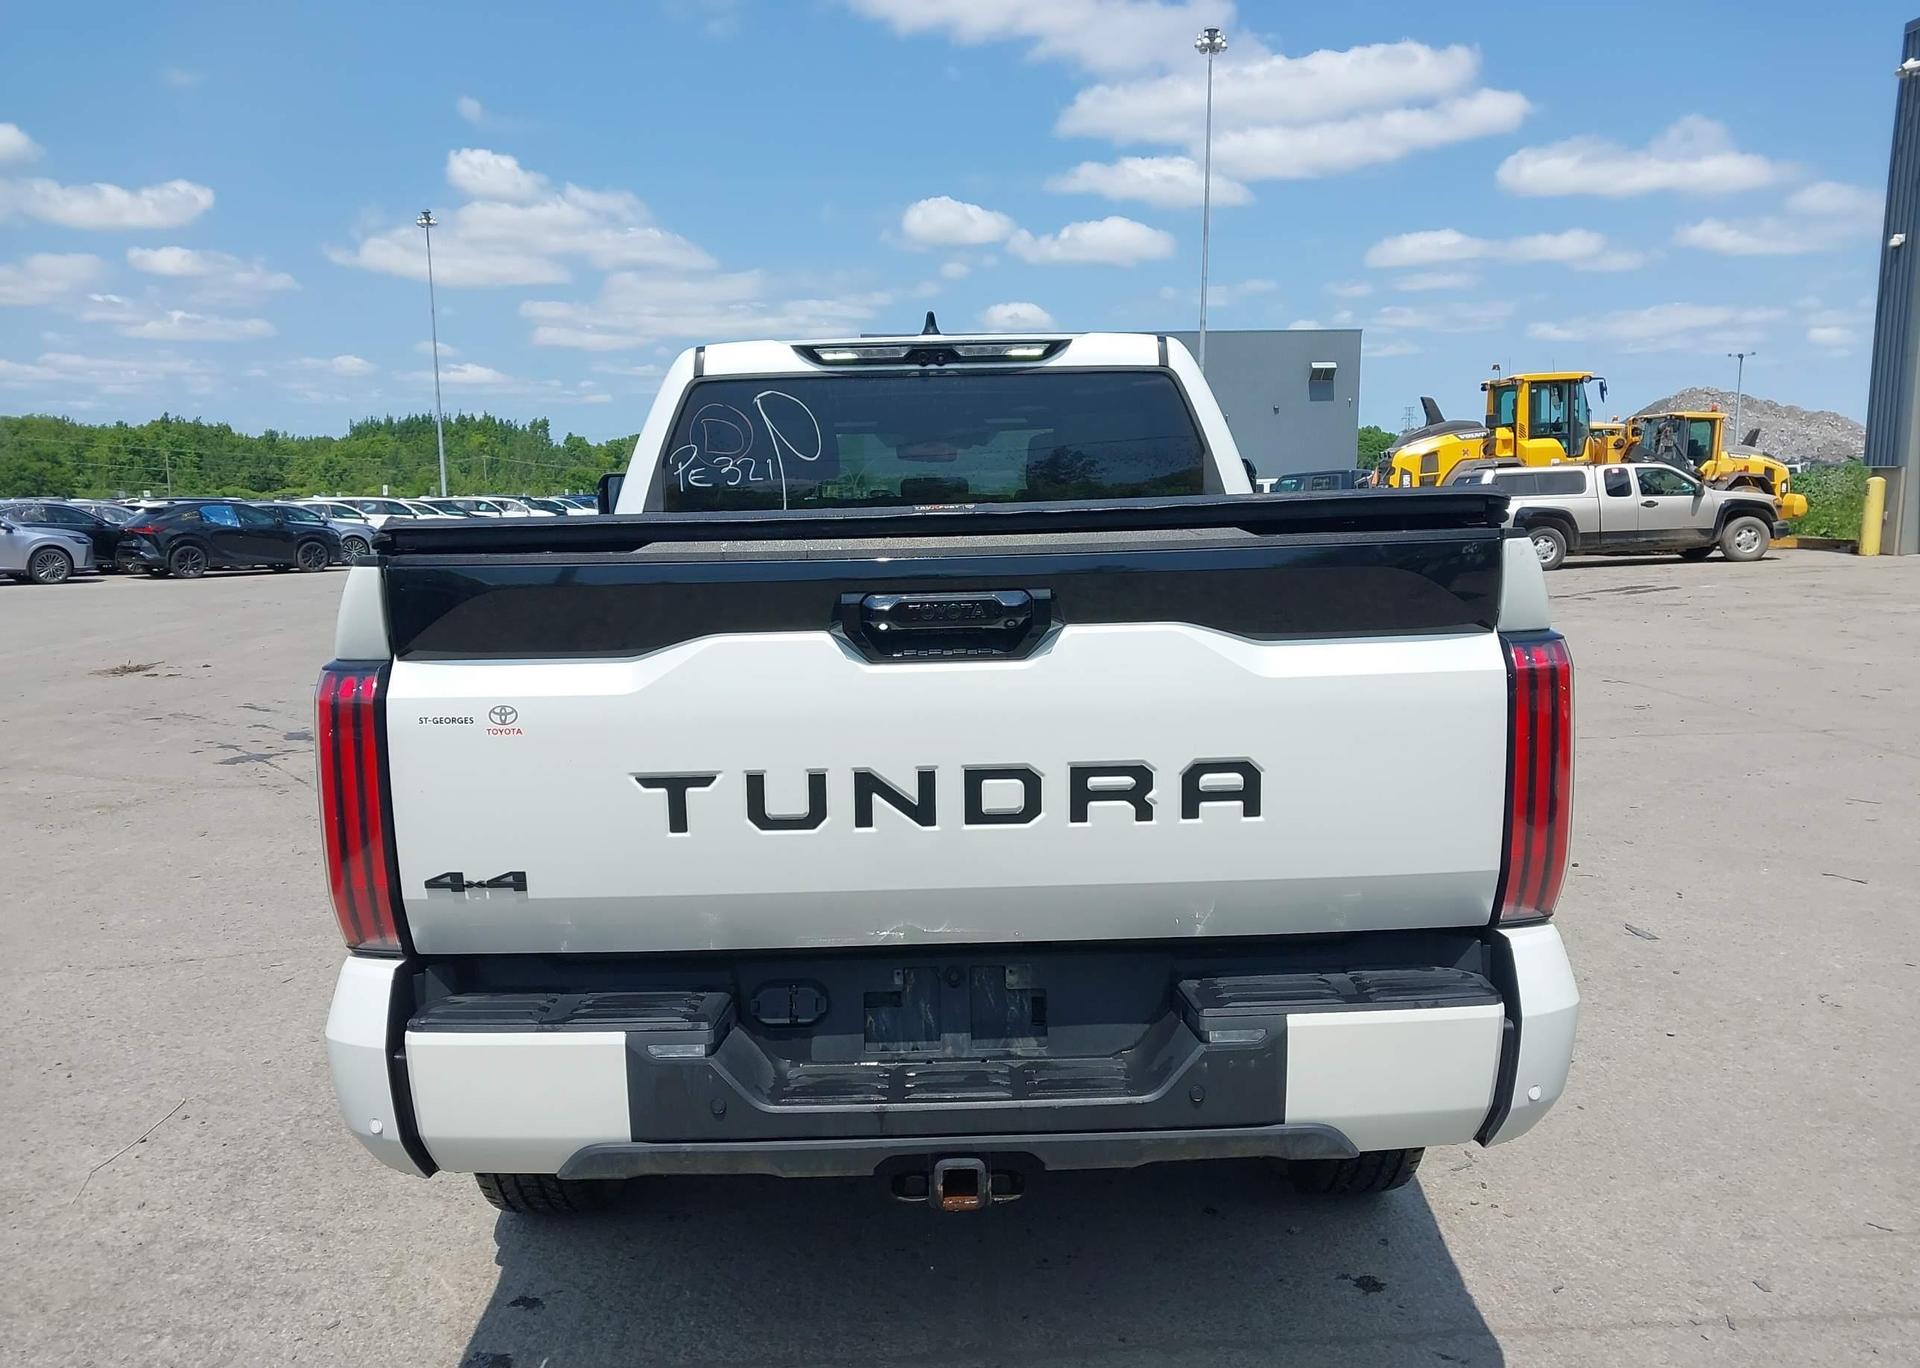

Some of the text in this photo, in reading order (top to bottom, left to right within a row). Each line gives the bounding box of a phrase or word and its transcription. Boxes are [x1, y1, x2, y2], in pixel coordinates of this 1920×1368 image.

[418, 716, 475, 725] ST-GEORGES
[486, 728, 523, 736] TOYOTA
[628, 757, 1265, 837] TUNDRA
[424, 871, 528, 893] 4x4
